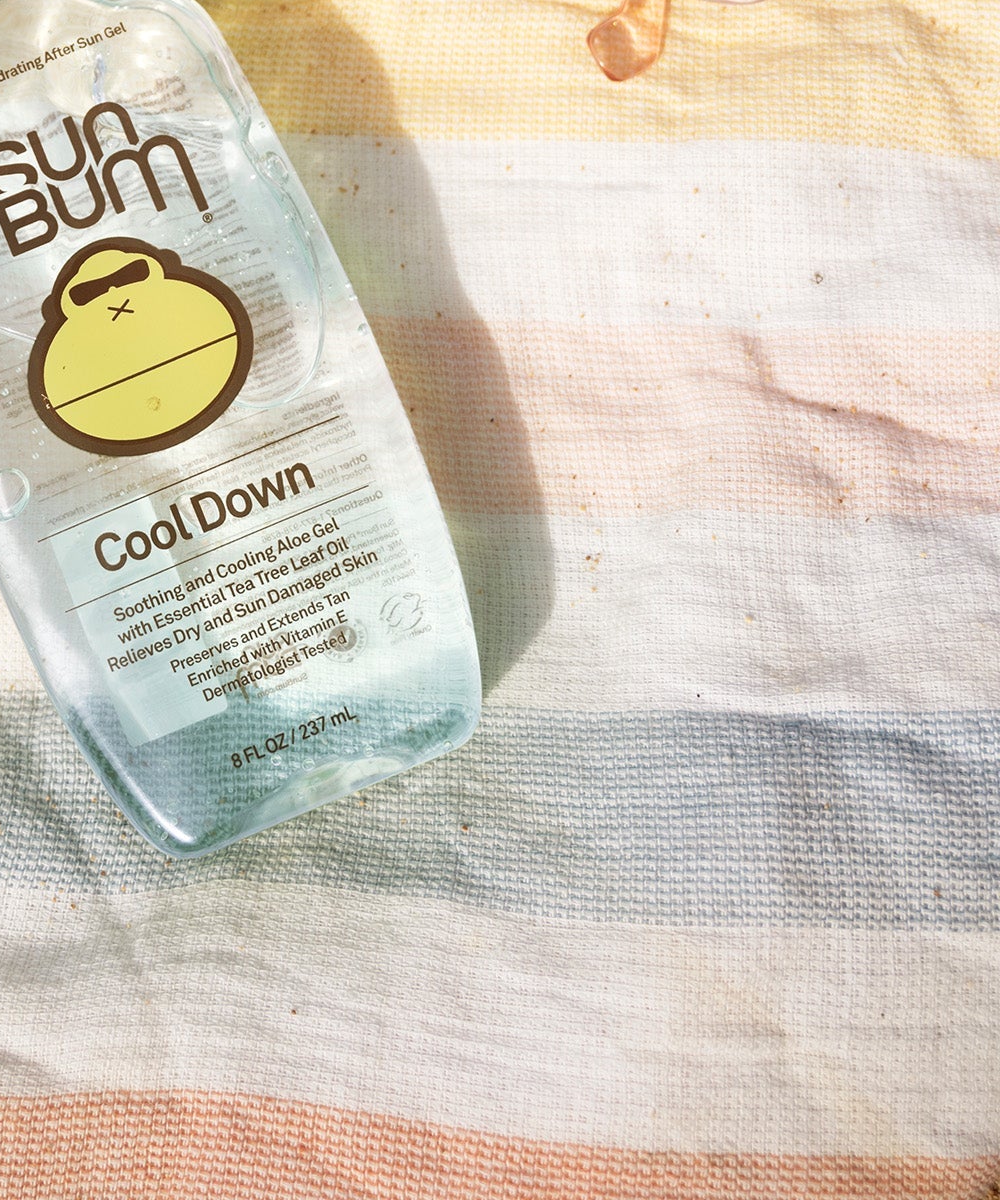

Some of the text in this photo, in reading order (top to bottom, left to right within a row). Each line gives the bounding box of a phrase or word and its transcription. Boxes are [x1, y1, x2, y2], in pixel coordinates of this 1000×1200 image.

[44, 42, 76, 64] After
[76, 32, 104, 50] Sun
[103, 21, 128, 39] Gel
[93, 502, 194, 572] Cool
[189, 462, 317, 534] Down
[106, 637, 173, 673] Relieves
[172, 623, 201, 645] Dry
[203, 607, 234, 633] and
[233, 597, 268, 619] Sun
[266, 561, 343, 605] Damaged
[341, 550, 379, 573] Skin
[113, 583, 186, 623] Soothing
[184, 568, 216, 593] and
[215, 545, 278, 579] Cooling
[277, 531, 312, 555] Aloe
[311, 516, 341, 539] Gel
[116, 620, 154, 645] with
[152, 587, 228, 630] Essential
[224, 578, 257, 598] Tea
[252, 564, 290, 586] Tree
[289, 544, 325, 572] Leaf
[325, 535, 350, 556] Oil
[169, 637, 240, 674] Preserves
[240, 622, 267, 644] and
[266, 600, 325, 632] Extends
[322, 590, 351, 608] Tan
[186, 650, 250, 688] Enriched
[249, 638, 283, 661] with
[279, 617, 337, 647] Vitamin
[335, 608, 349, 625] E
[201, 651, 302, 703] Dermatologist
[298, 630, 348, 660] Tested
[230, 752, 243, 769] 8
[242, 744, 267, 764] FL
[264, 732, 290, 754] OZ
[297, 715, 326, 741] 237
[329, 705, 358, 728] mL
